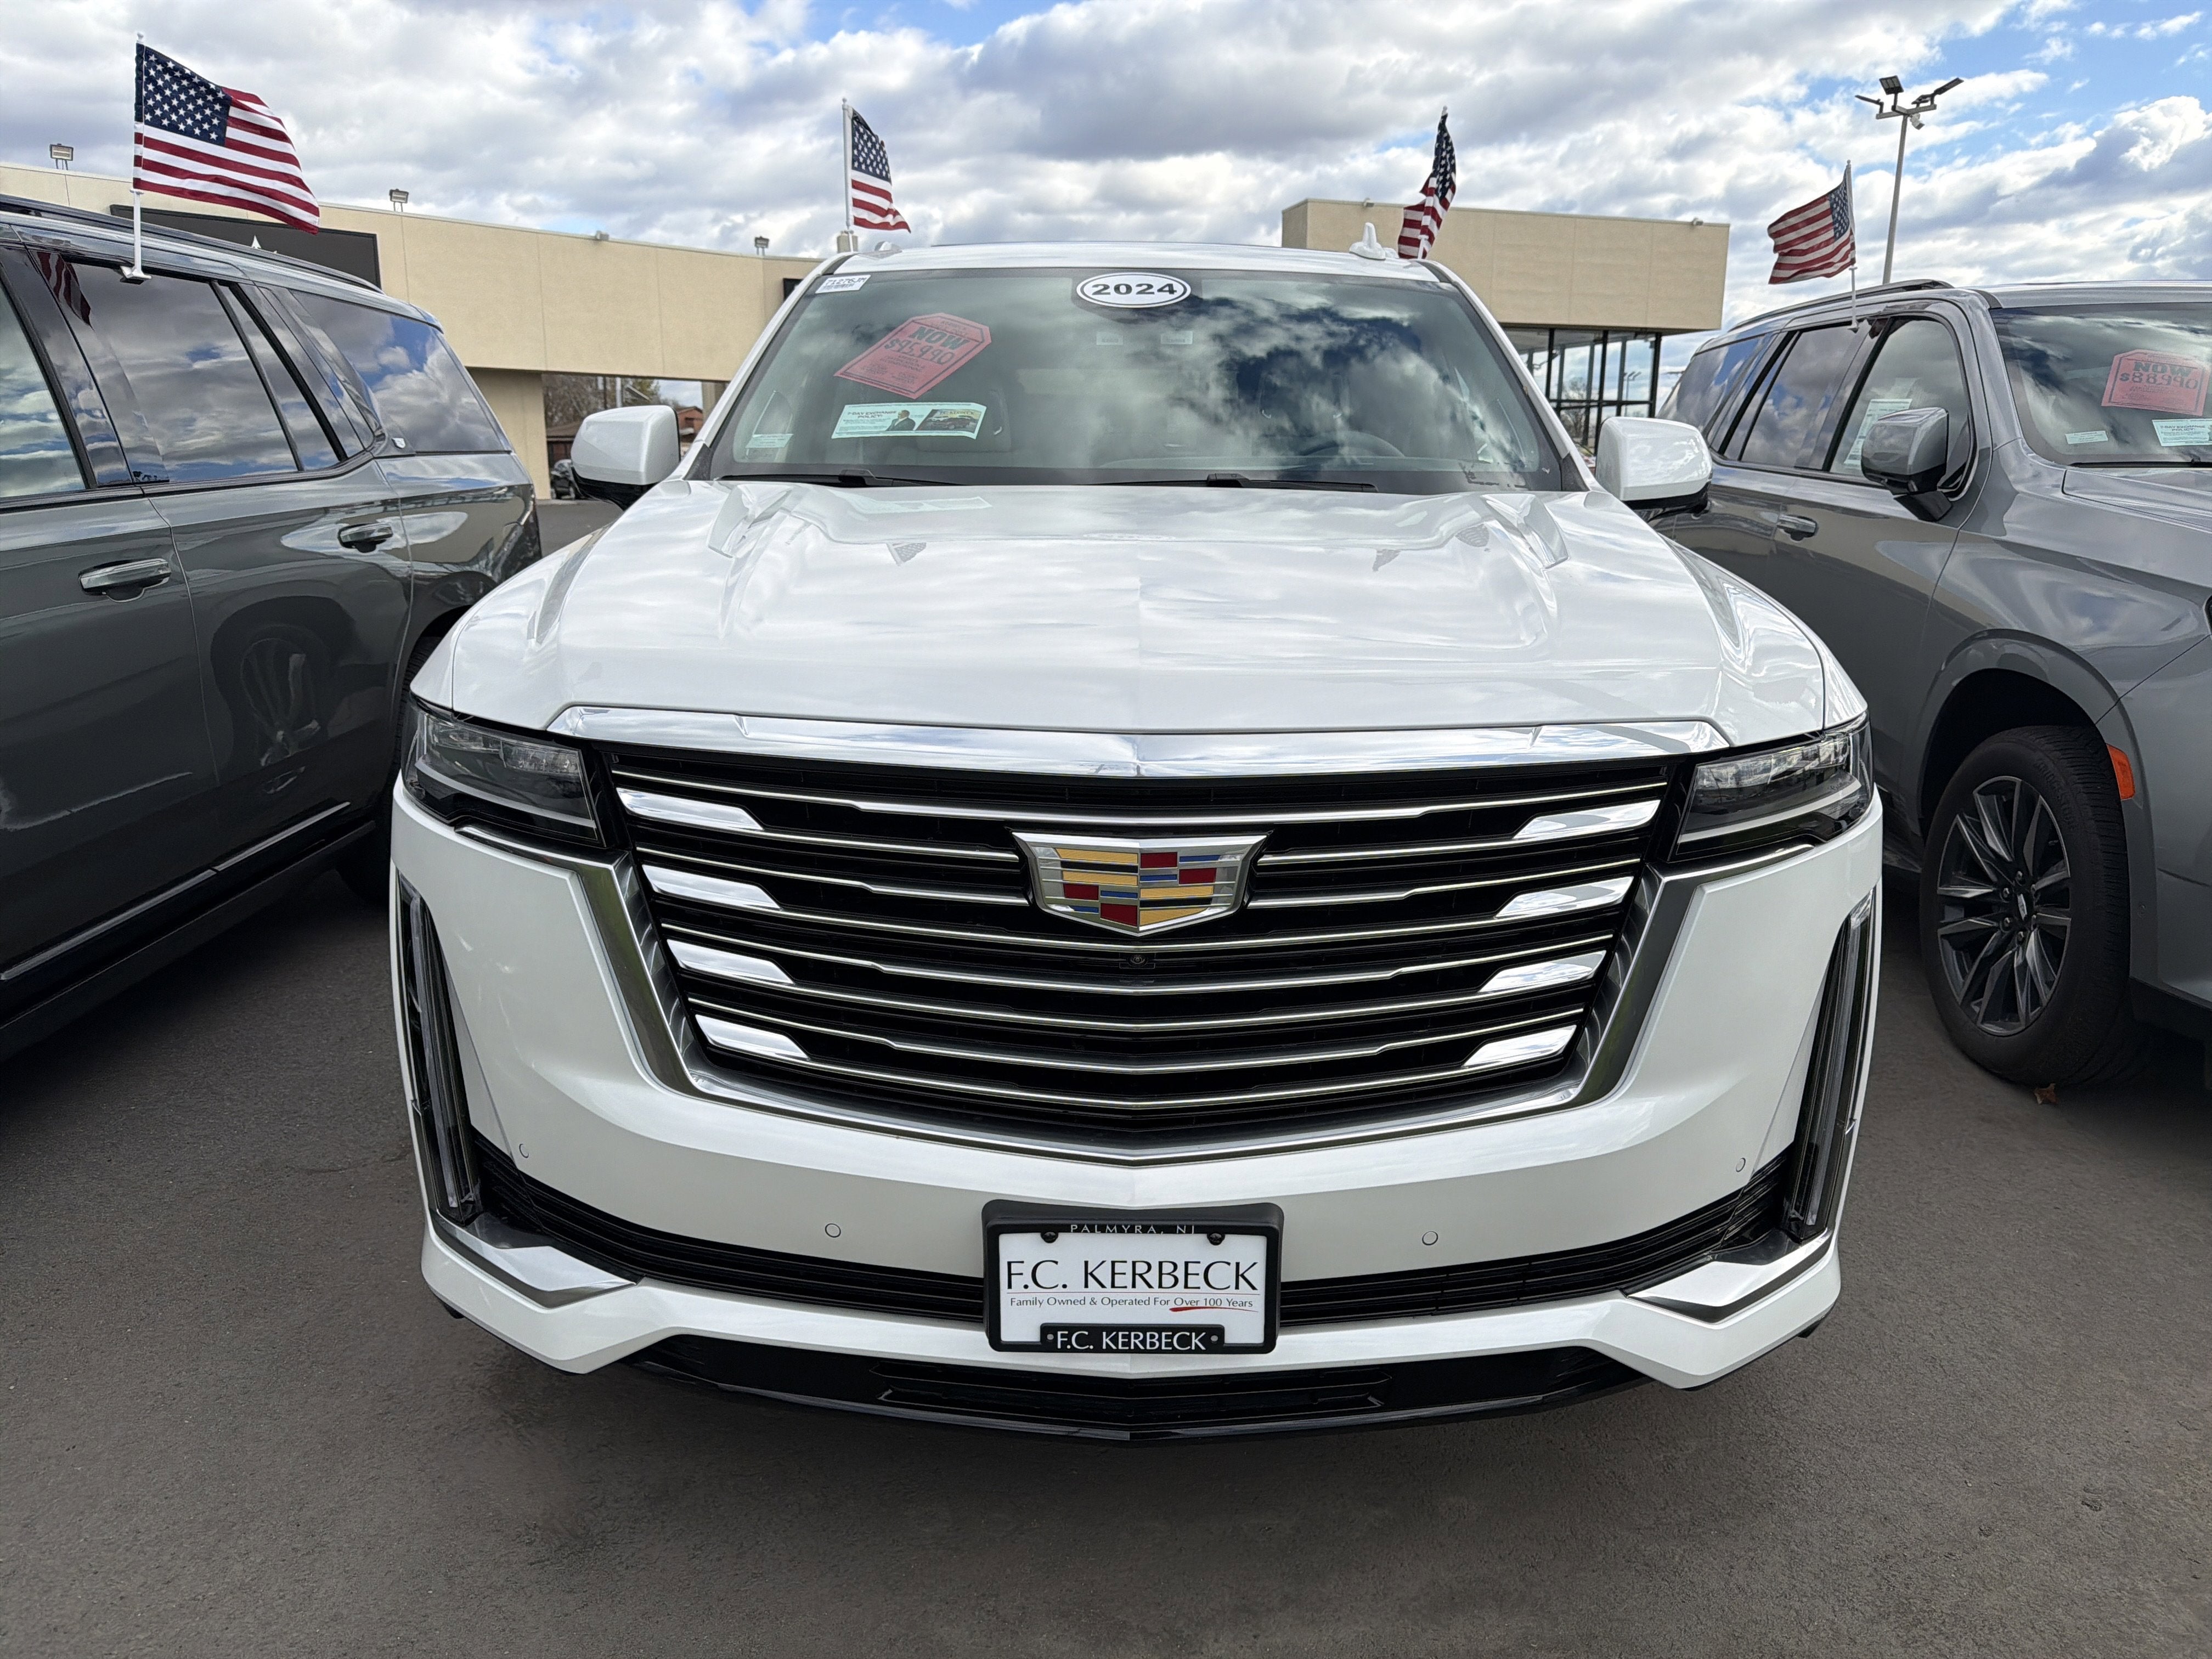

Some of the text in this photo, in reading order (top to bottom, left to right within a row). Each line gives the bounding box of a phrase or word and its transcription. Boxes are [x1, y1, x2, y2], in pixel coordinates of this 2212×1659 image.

[1092, 283, 1177, 295] 2024
[908, 326, 970, 350] NOW
[2134, 362, 2192, 377] NOW
[1007, 1260, 1258, 1290] F.C. KERBECK
[1011, 1297, 1044, 1308] Family
[1047, 1296, 1086, 1306] Owned
[1090, 1297, 1097, 1306] &
[1101, 1297, 1150, 1307] Operated
[1154, 1297, 1170, 1306] For
[1174, 1297, 1200, 1306] Over
[1227, 1299, 1253, 1307] Years
[1057, 1331, 1206, 1350] F.C. KERBECK
